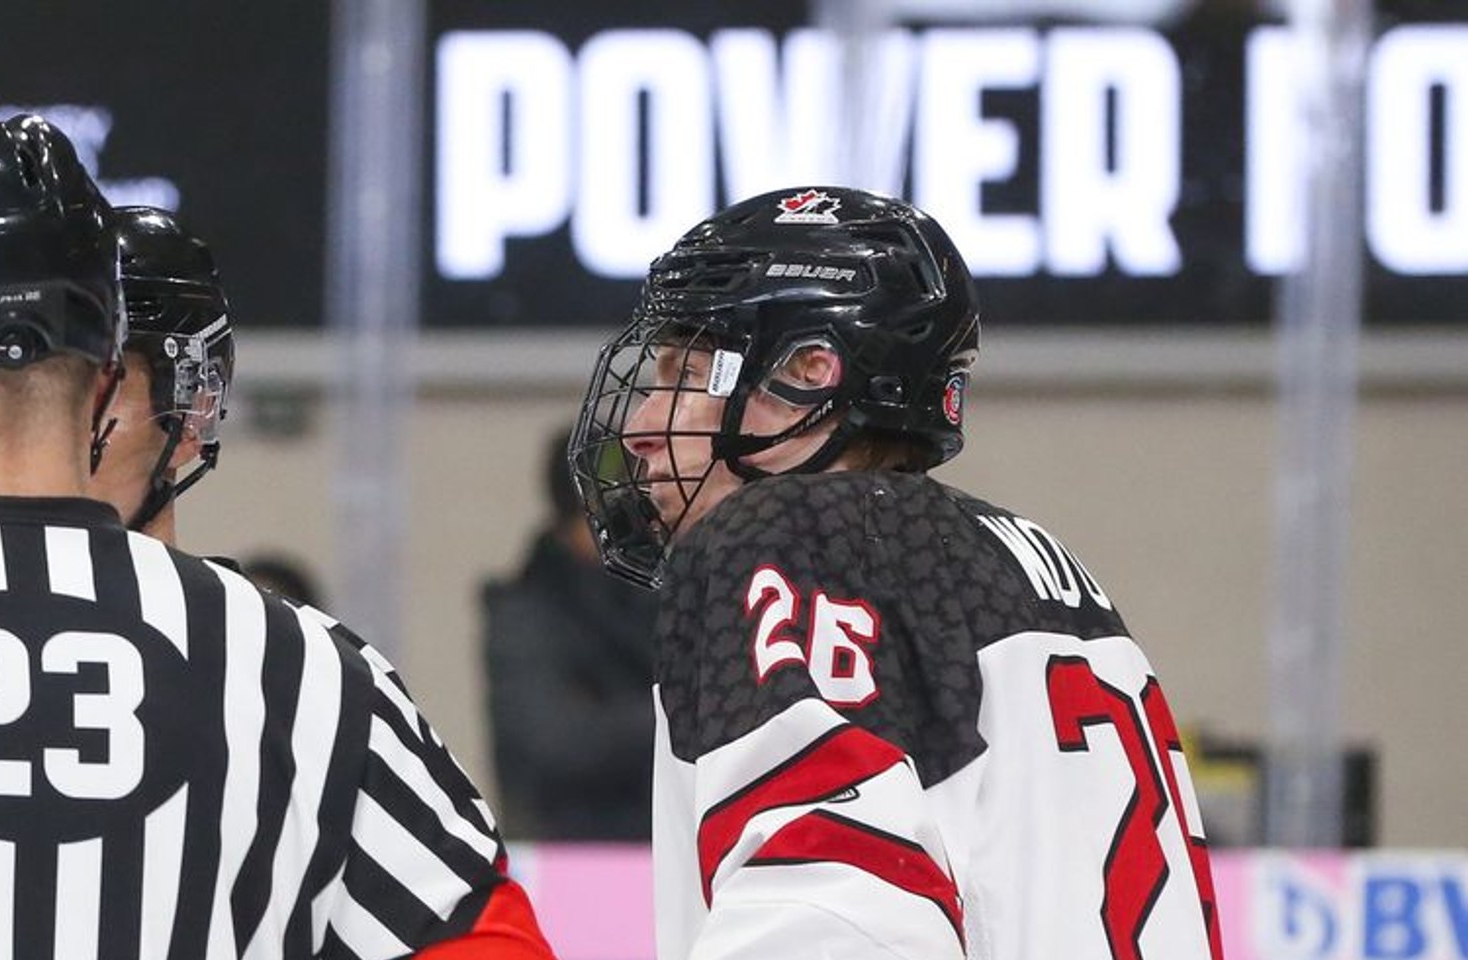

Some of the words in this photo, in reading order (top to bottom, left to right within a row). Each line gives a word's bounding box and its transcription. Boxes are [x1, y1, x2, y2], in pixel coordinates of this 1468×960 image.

[435, 28, 1183, 280] POWER
[765, 264, 857, 281] BAUER
[744, 563, 881, 708] 26
